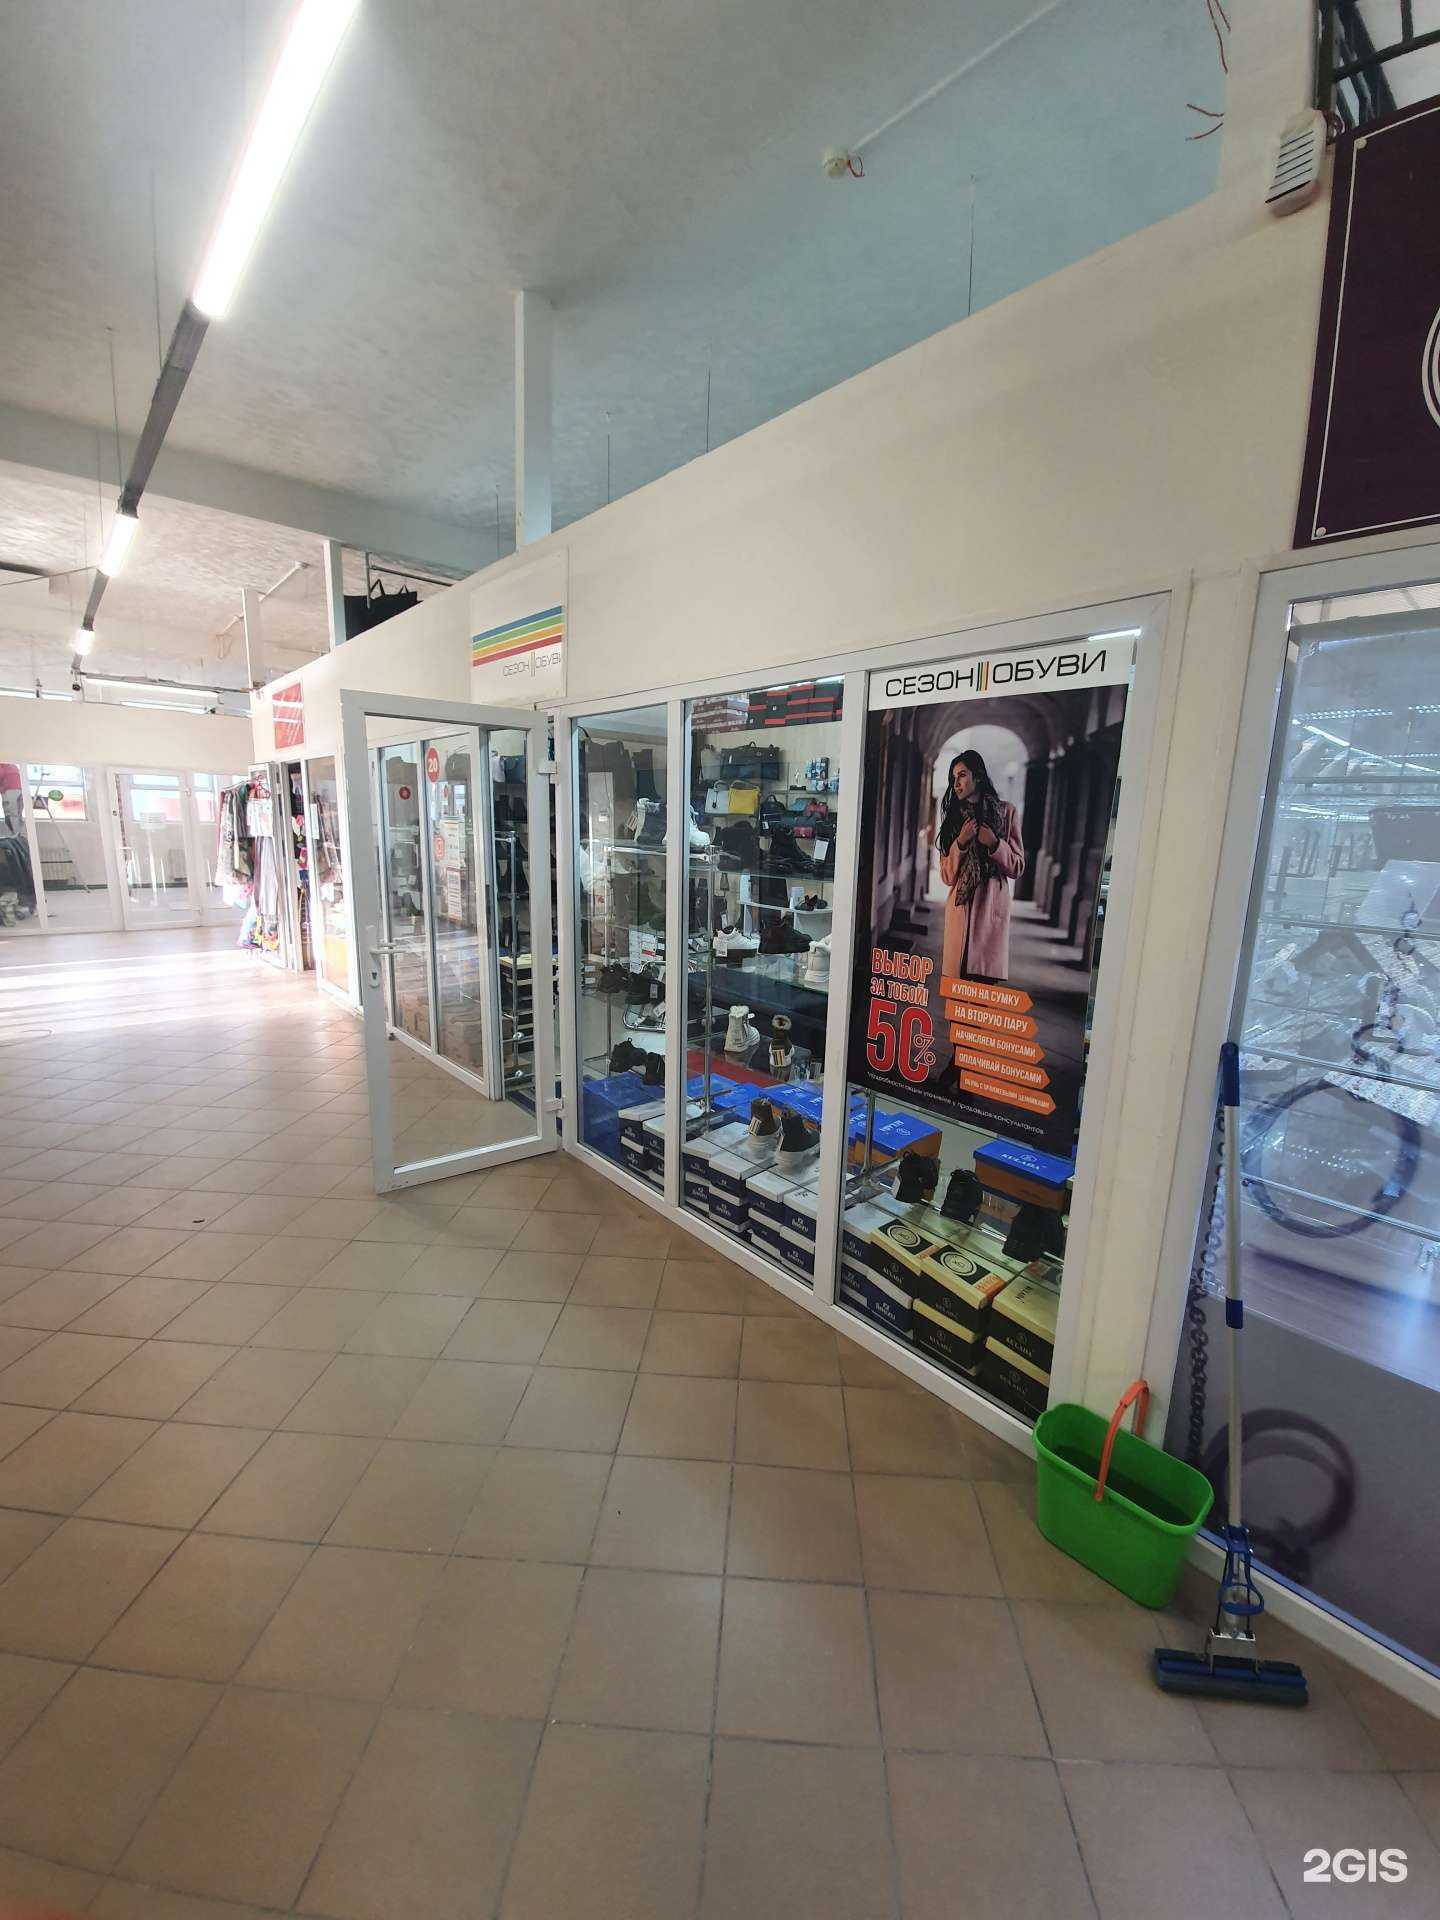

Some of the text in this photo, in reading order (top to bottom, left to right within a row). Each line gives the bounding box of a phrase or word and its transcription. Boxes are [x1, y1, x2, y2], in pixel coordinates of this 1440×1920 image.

[503, 660, 530, 677] СЕЗОН
[885, 650, 1107, 697] СЕЗОН ОБУВИ
[872, 948, 934, 983] ВЫБОР
[870, 977, 929, 1007] ЗА ТОБОЙ!
[952, 983, 1020, 1007] КУПОН НА СУМКУ
[954, 1005, 1028, 1033] НА ВТОРУЮ ПАРУ
[866, 997, 937, 1083] 50%
[955, 1029, 1036, 1057] НАЧИСЛЯЕМ БОНУСАМИ
[959, 1053, 1041, 1084] ОПЛАЧИВАЙ БОНУСАМИ
